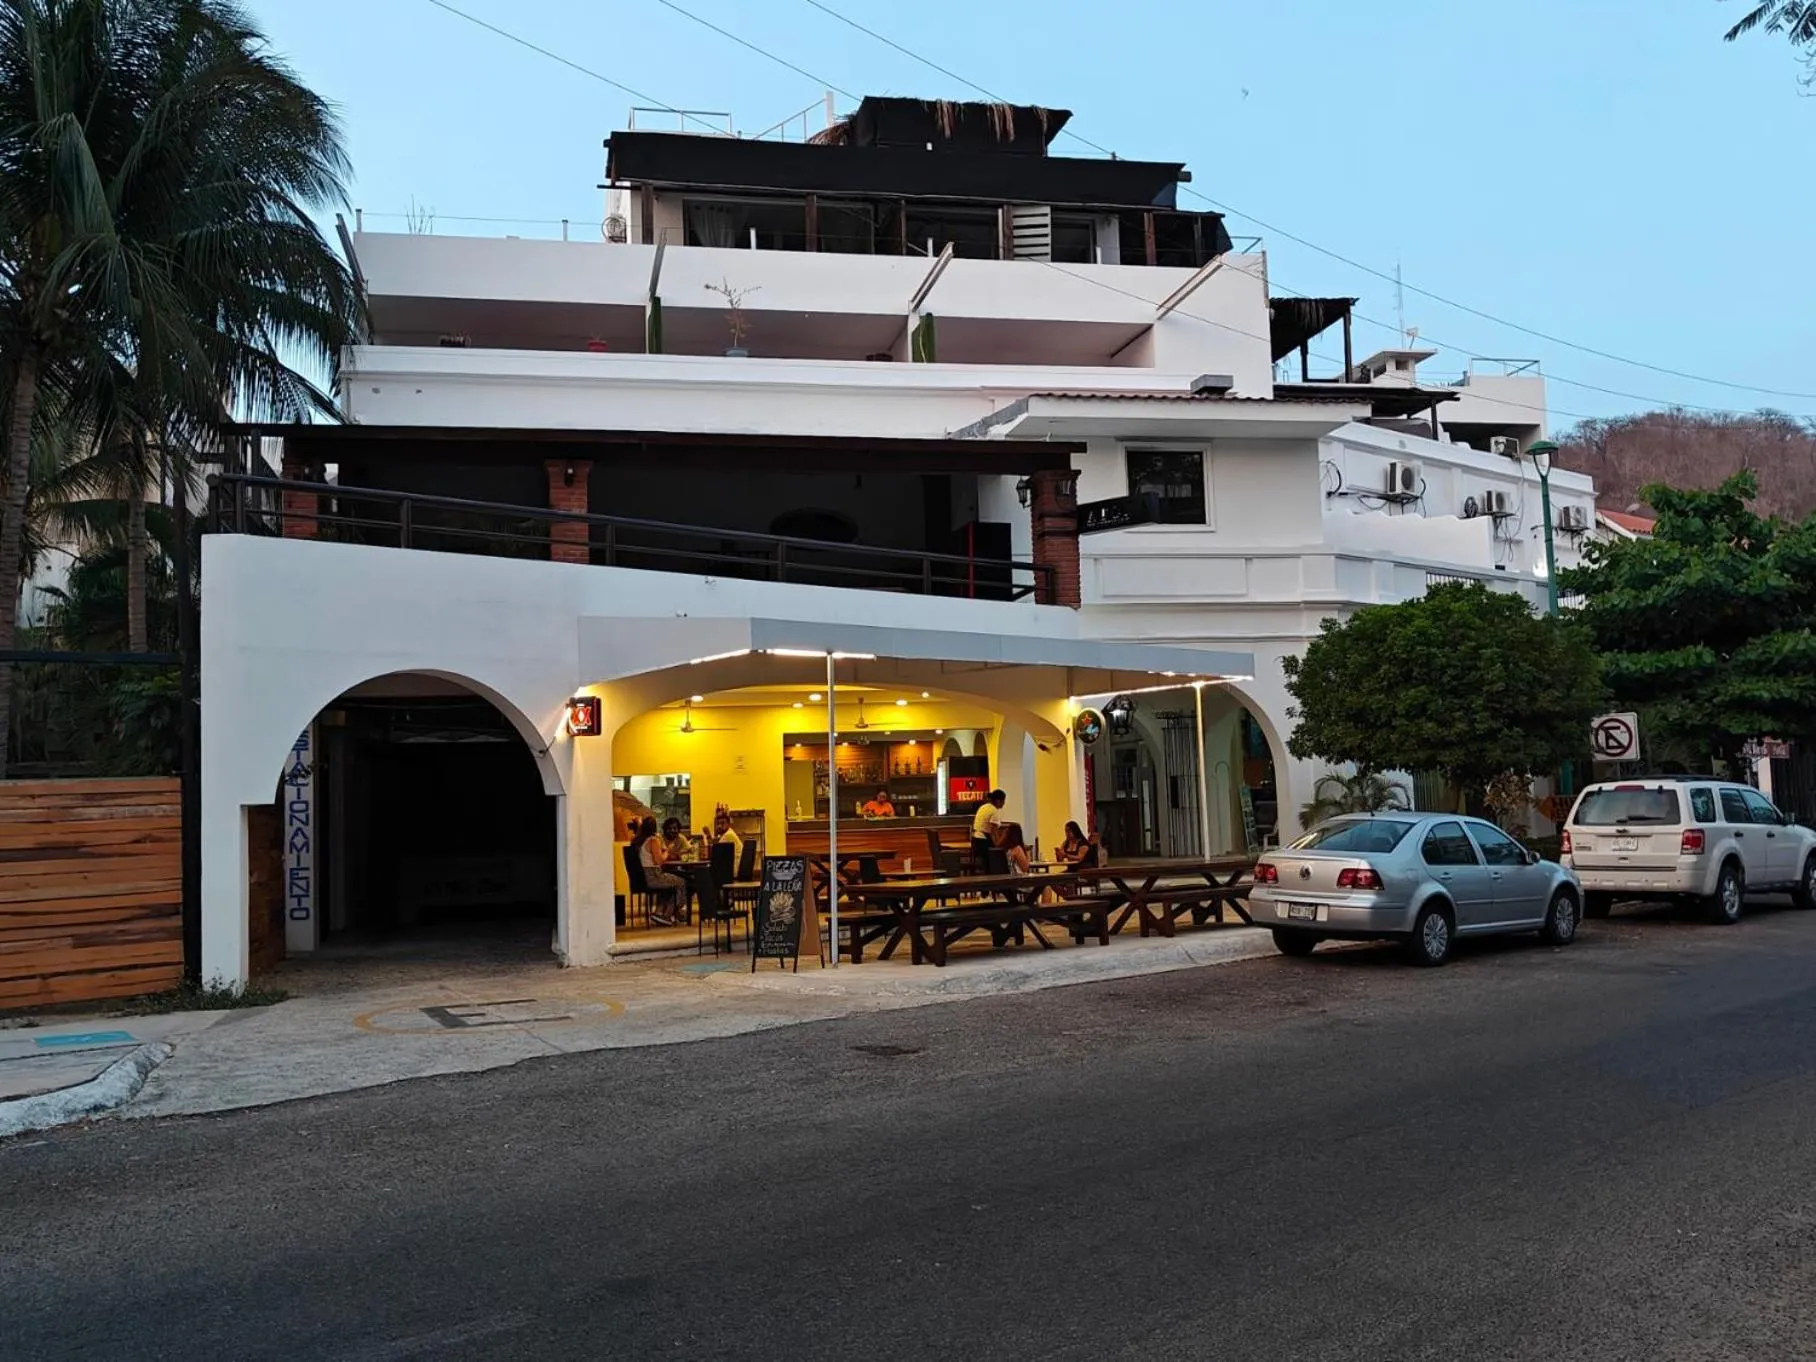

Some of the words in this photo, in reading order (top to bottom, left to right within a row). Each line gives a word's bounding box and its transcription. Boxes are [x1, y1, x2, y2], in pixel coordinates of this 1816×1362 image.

[957, 791, 985, 801] TECAT
[288, 730, 311, 921] STAIONAMIENTO
[766, 859, 804, 874] PIZZAS
[763, 880, 770, 892] A
[772, 880, 782, 892] LA
